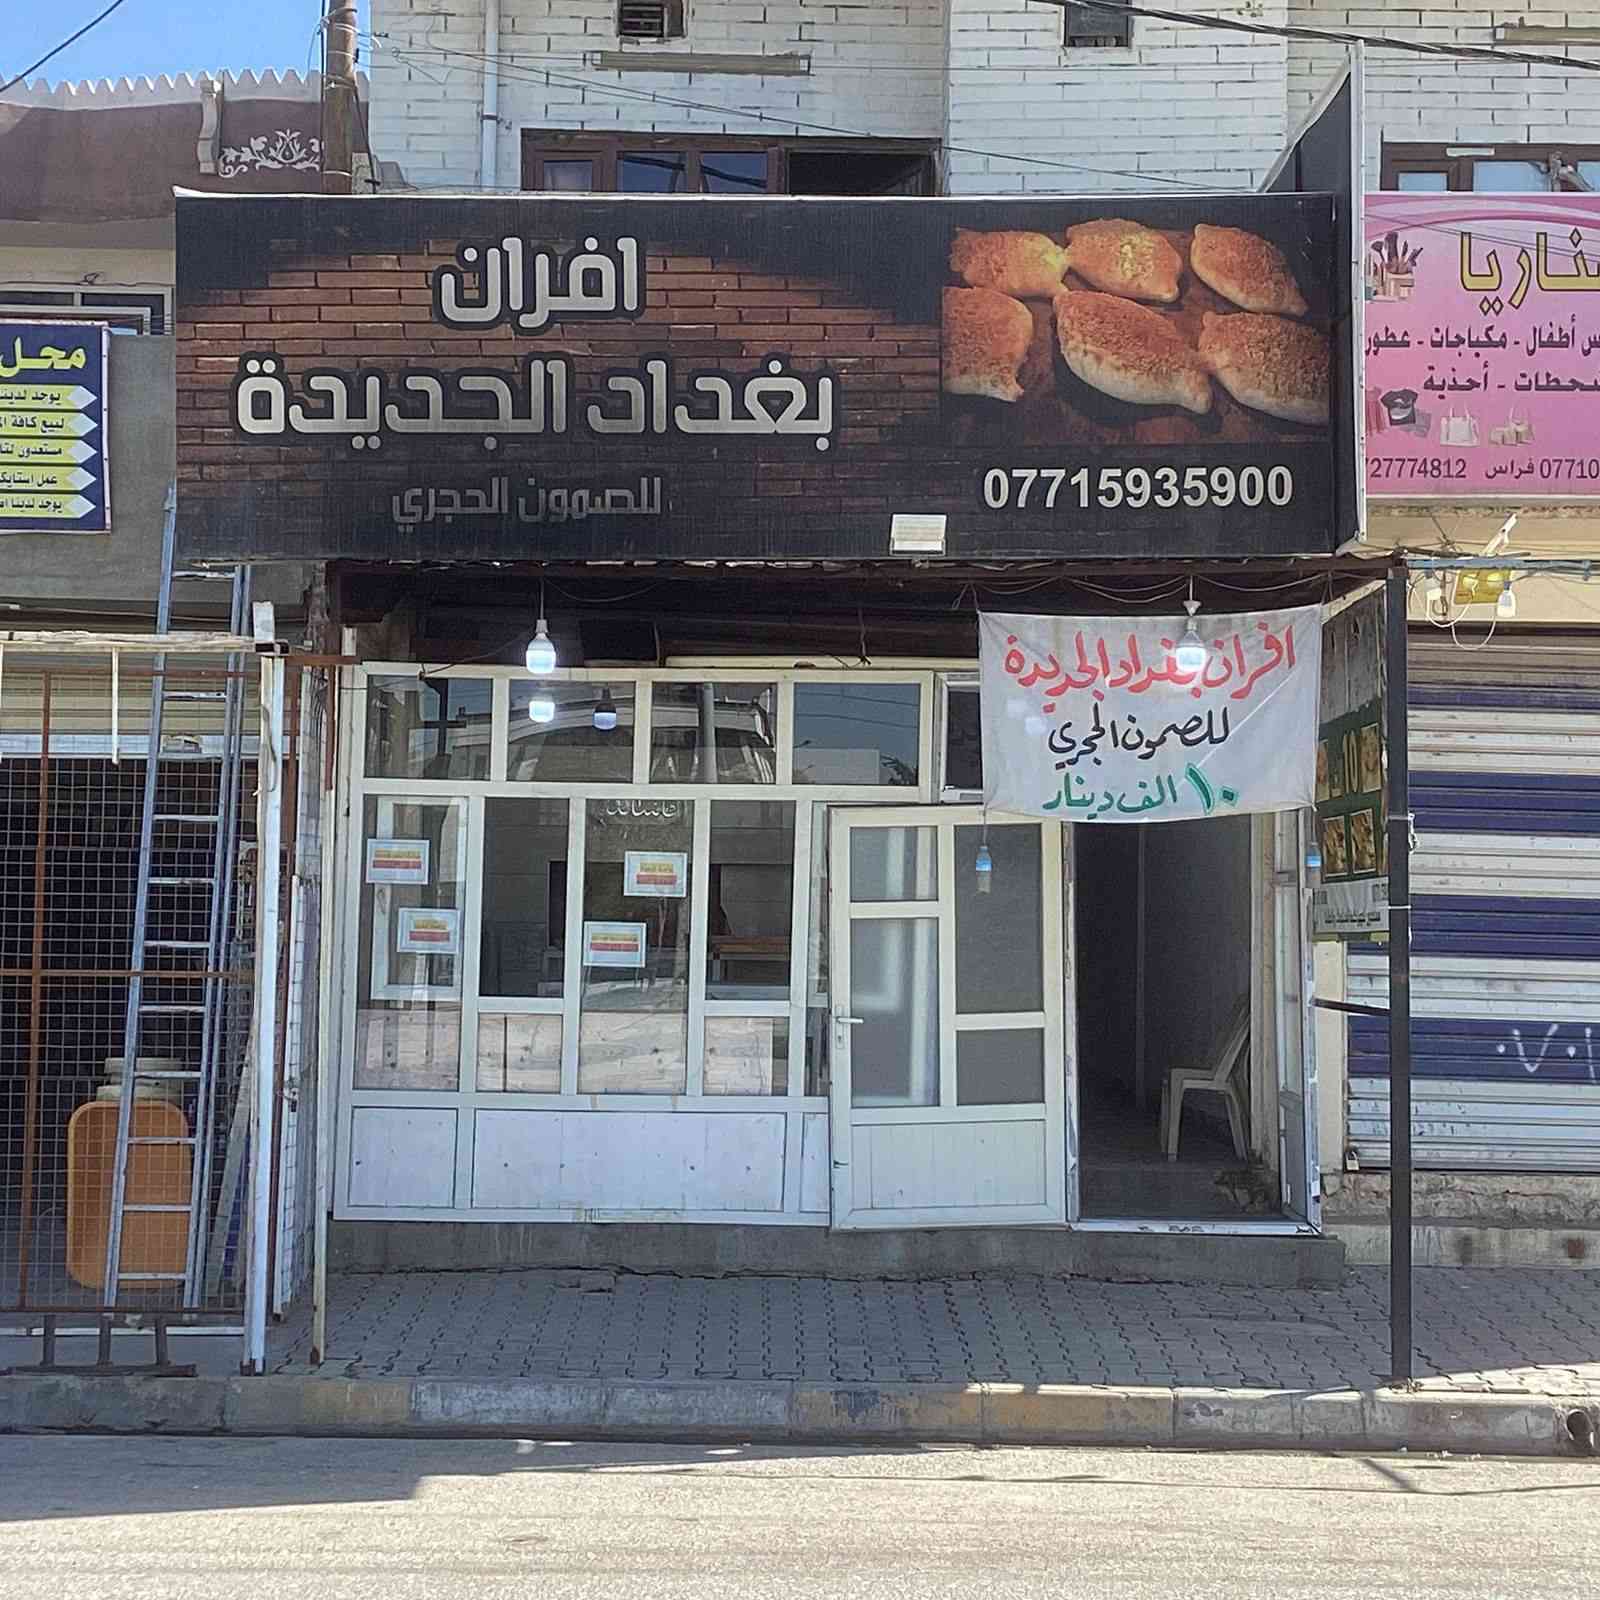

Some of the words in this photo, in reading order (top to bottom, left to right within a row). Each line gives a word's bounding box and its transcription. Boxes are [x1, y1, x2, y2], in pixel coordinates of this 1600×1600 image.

[440, 236, 638, 328] افران
[1460, 227, 1600, 316] ناريا
[0, 335, 87, 378] محل
[1365, 325, 1411, 357] عطور
[1526, 313, 1576, 357] أطفال
[237, 358, 567, 450] الجديدة
[1423, 360, 1489, 399] أحذية
[587, 359, 833, 451] بغداد
[982, 465, 1294, 509] 07715935900
[1366, 458, 1467, 479] 27774812
[1484, 458, 1535, 480] فراس
[392, 476, 510, 533] الحجري
[1004, 630, 1111, 713] الجديدة
[1202, 621, 1297, 699] افران
[1121, 706, 1230, 760] للصمون
[1042, 772, 1114, 821] دينار
[1116, 774, 1178, 813] الف
